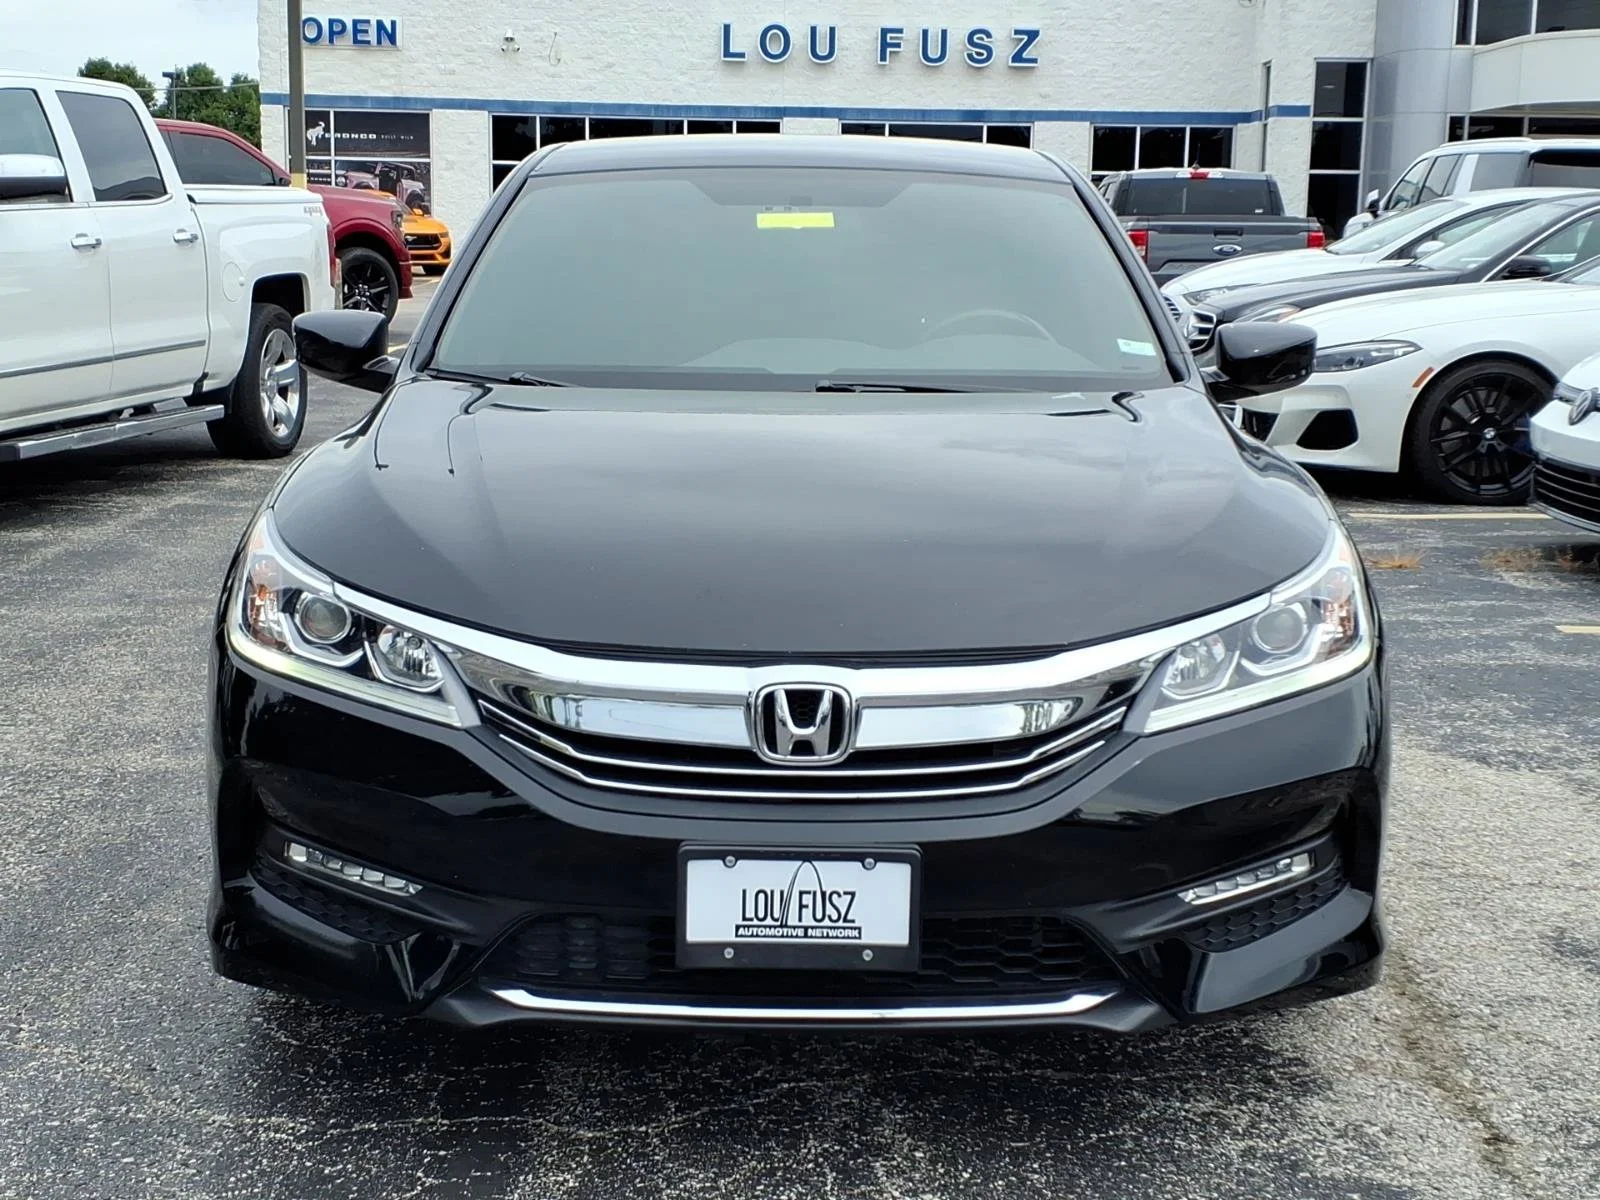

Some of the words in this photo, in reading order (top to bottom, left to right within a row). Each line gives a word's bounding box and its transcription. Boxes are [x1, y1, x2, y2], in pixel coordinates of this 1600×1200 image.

[302, 16, 397, 46] OPEN
[721, 22, 838, 64] LOU
[877, 26, 1041, 67] FUSZ
[741, 888, 784, 922] LOU
[798, 889, 857, 924] FUSZ
[737, 926, 805, 937] AUTOMOTIVE
[807, 927, 860, 938] NETWORK
